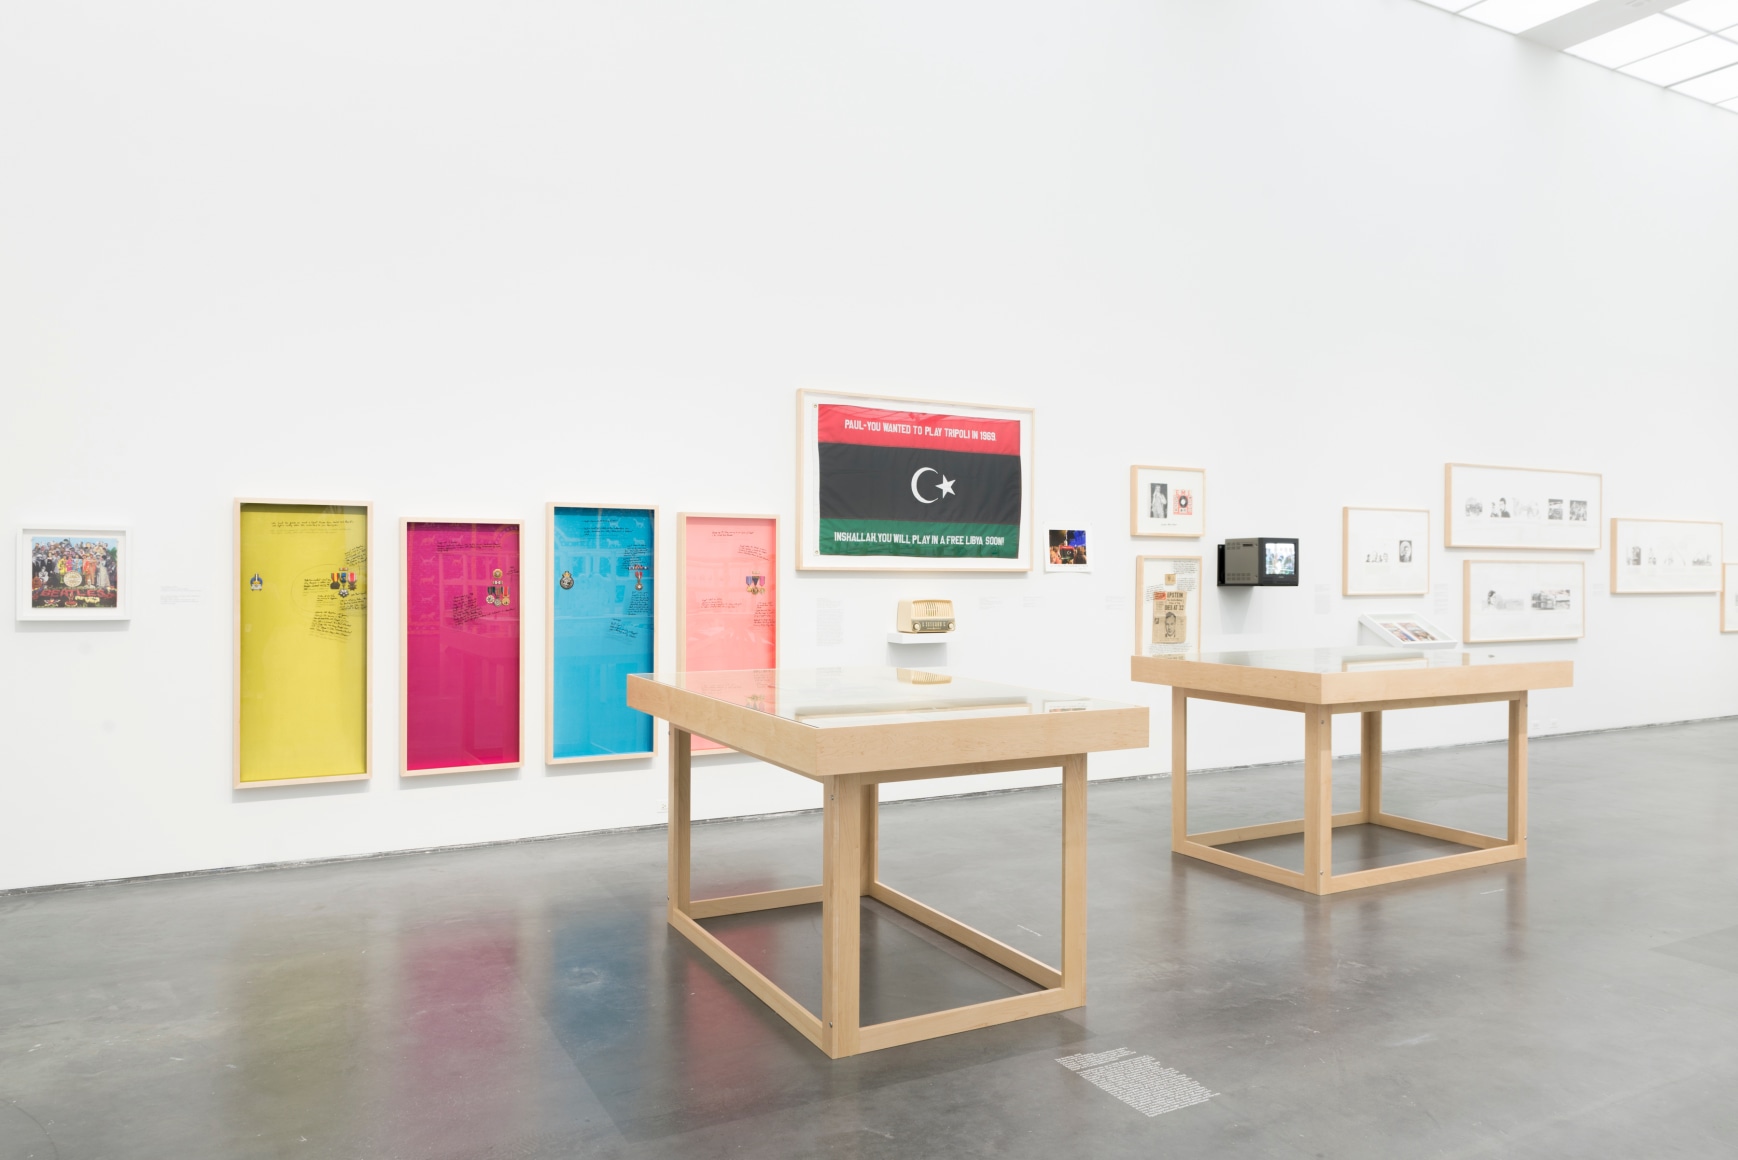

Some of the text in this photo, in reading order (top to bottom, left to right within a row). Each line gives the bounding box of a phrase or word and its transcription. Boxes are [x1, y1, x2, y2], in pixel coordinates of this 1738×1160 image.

[882, 422, 911, 434] WANTED
[912, 425, 923, 436] TO
[924, 426, 942, 437] PLAY
[944, 427, 970, 439] TRIPOLI
[971, 430, 978, 440] IN
[878, 533, 892, 543] YOU
[893, 533, 911, 544] WILL
[912, 534, 930, 545] PLAY
[931, 535, 938, 545] IN
[940, 535, 946, 545] A
[946, 536, 964, 545] FREE
[966, 536, 984, 546] LIBYA
[985, 536, 1005, 546] SOON!
[41, 589, 107, 598] BEATLES
